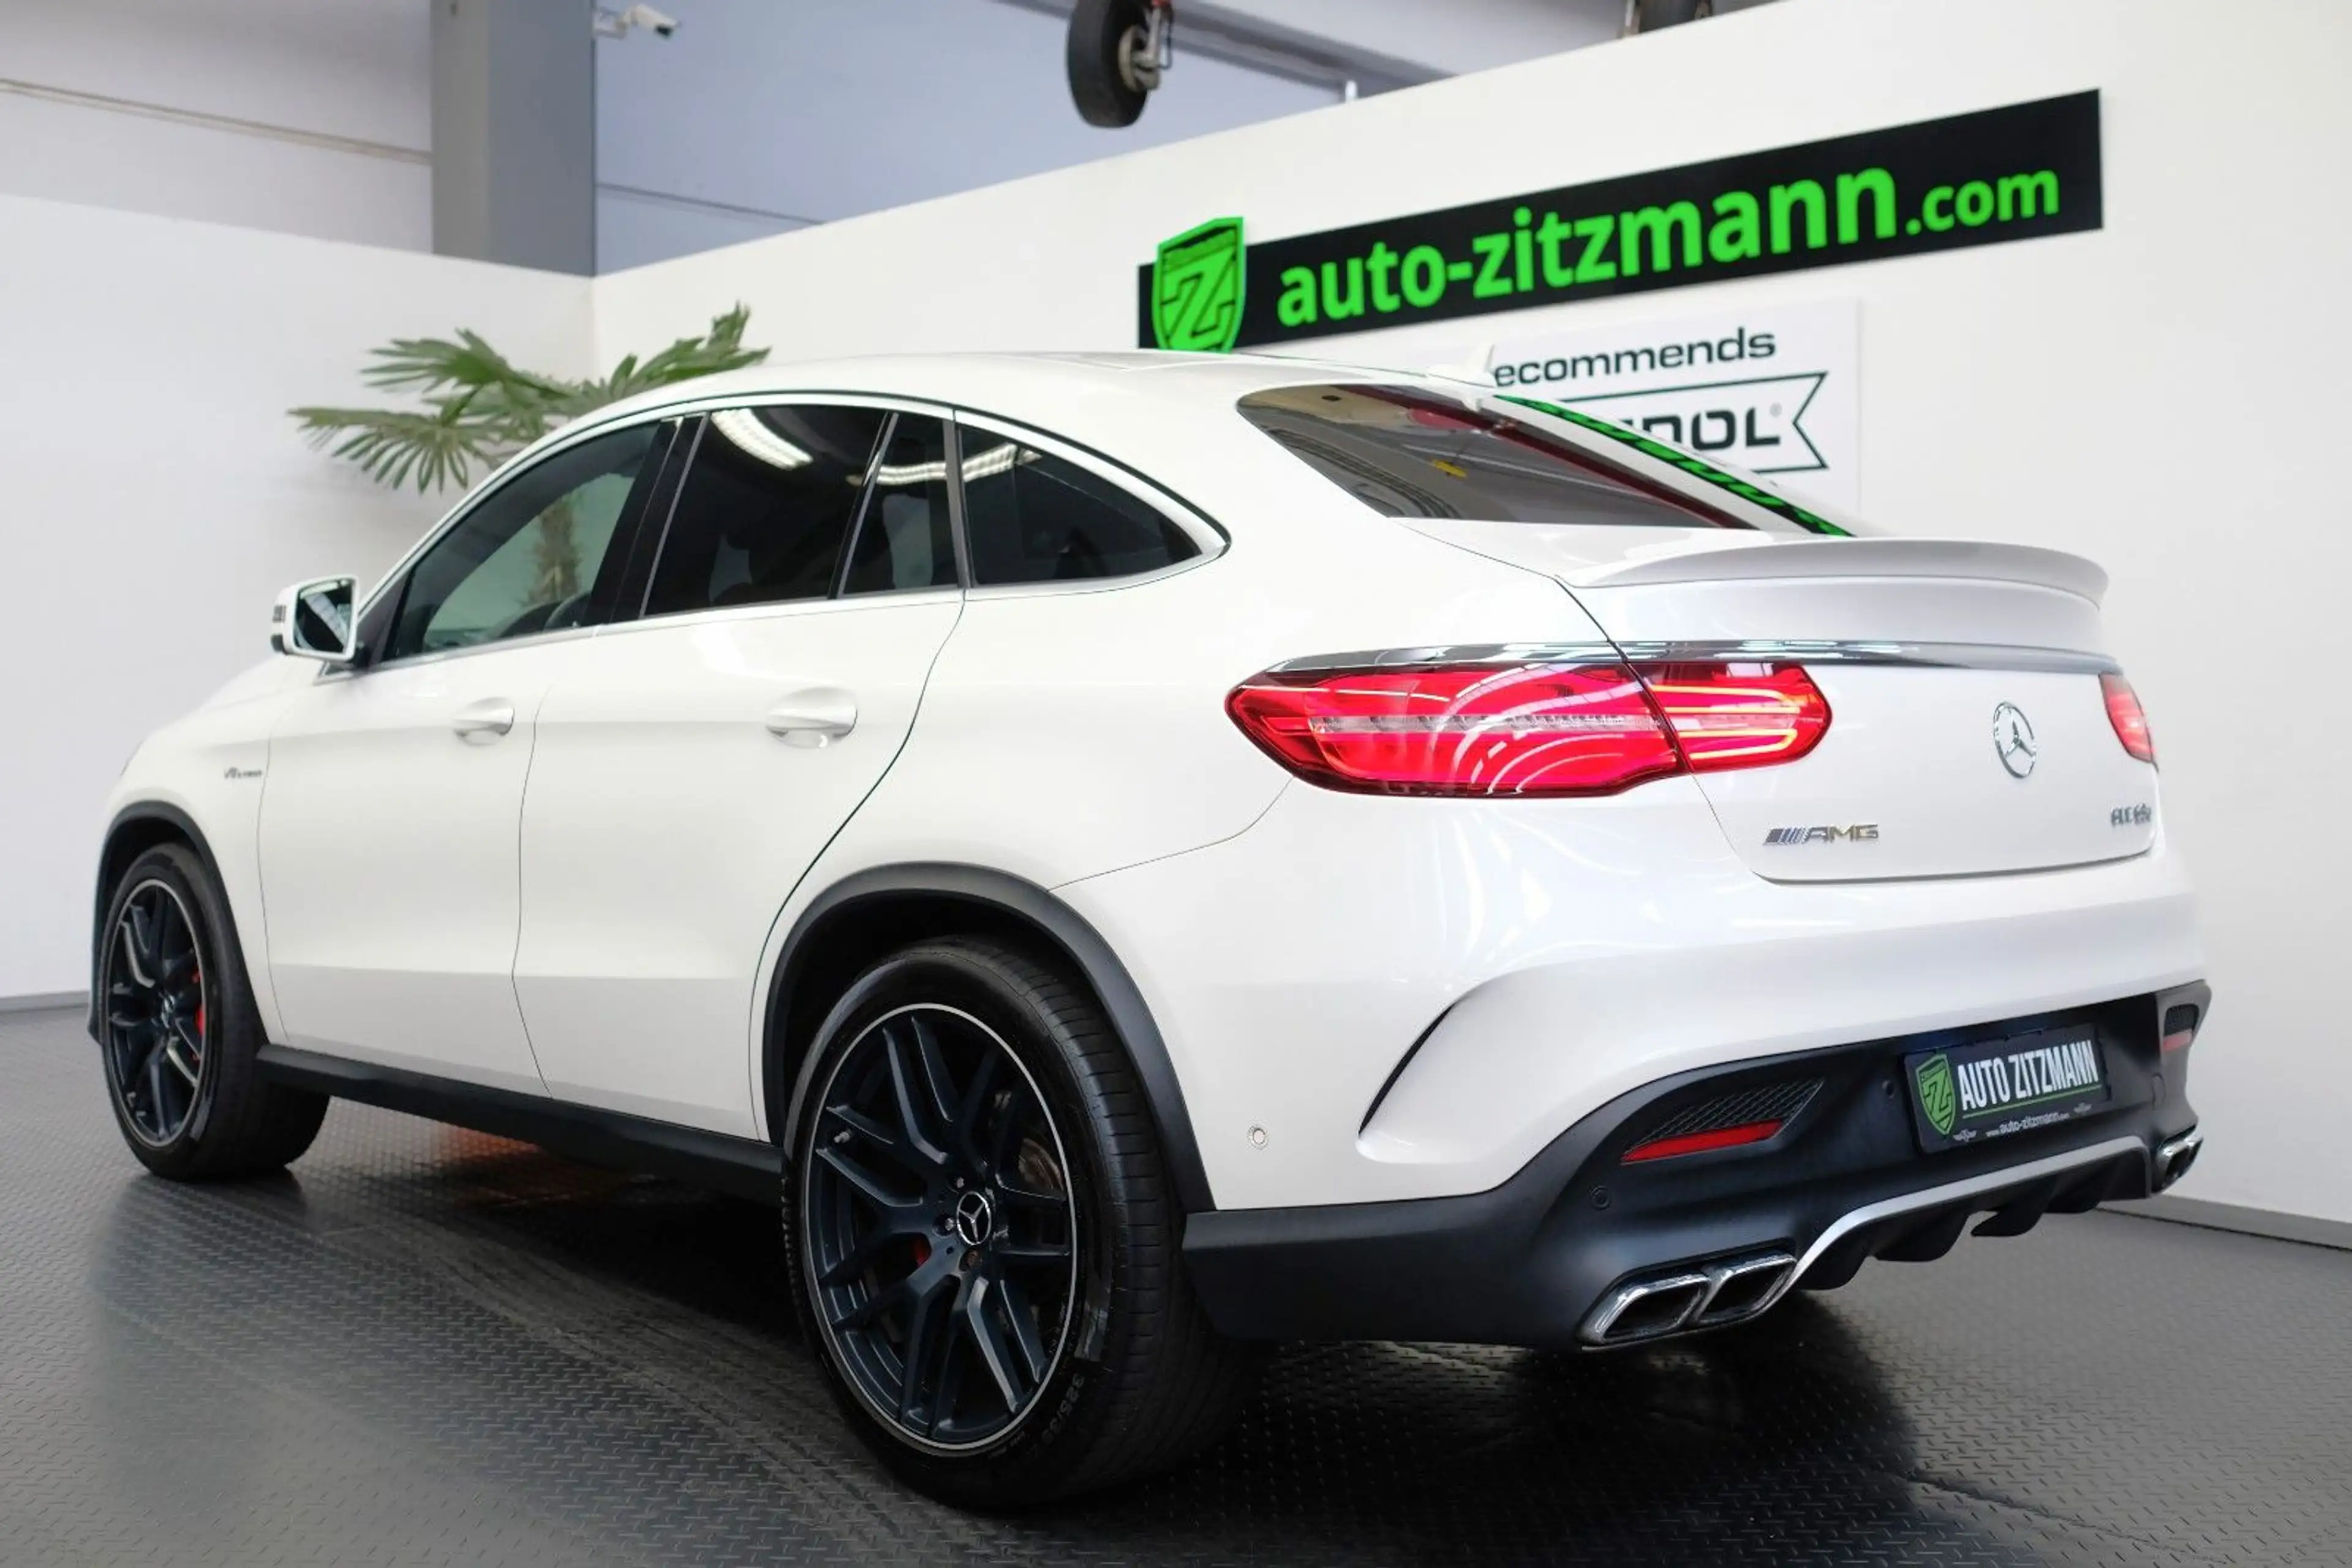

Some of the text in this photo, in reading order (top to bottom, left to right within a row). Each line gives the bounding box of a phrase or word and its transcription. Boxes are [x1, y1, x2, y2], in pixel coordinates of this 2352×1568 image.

[1278, 167, 2059, 326] auto-zitzmann.com
[1494, 327, 1776, 383] ecommends
[1958, 1039, 2099, 1110] AUTO ZITZMANN
